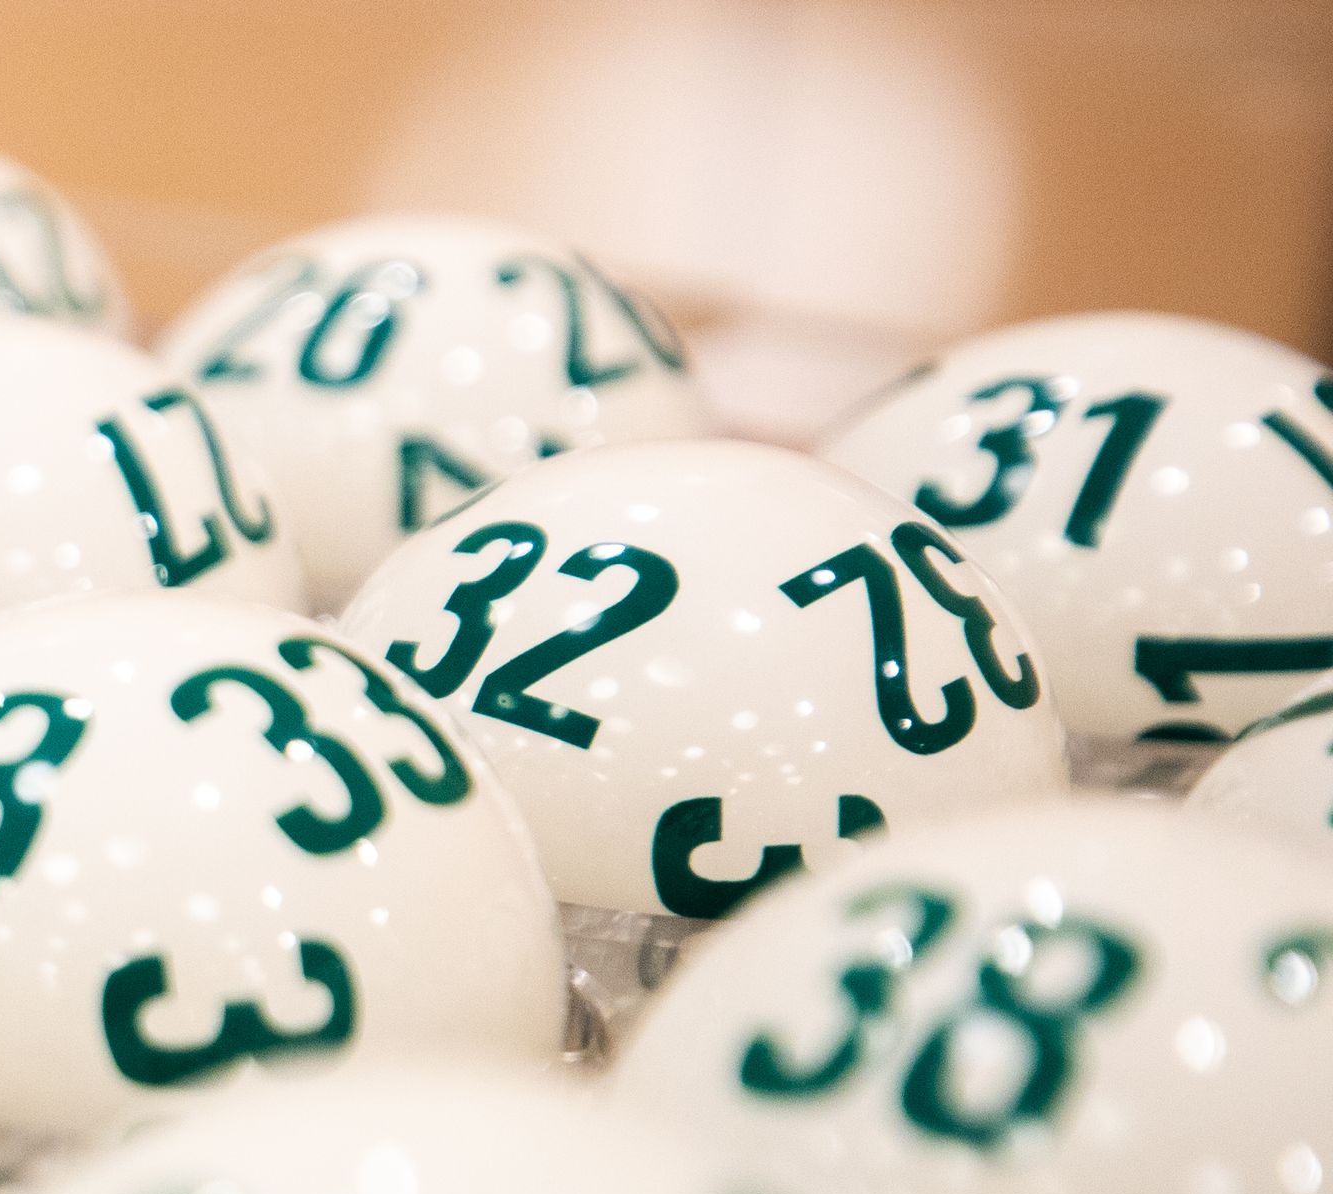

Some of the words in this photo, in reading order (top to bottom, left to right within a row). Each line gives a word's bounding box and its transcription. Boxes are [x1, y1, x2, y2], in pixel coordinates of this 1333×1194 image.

[97, 387, 275, 587] 27
[913, 375, 1171, 550] 31
[169, 635, 475, 856] 33
[385, 520, 681, 751] 32
[777, 520, 1041, 757] 32
[100, 936, 360, 1088] 3
[735, 880, 1149, 1150] 38
